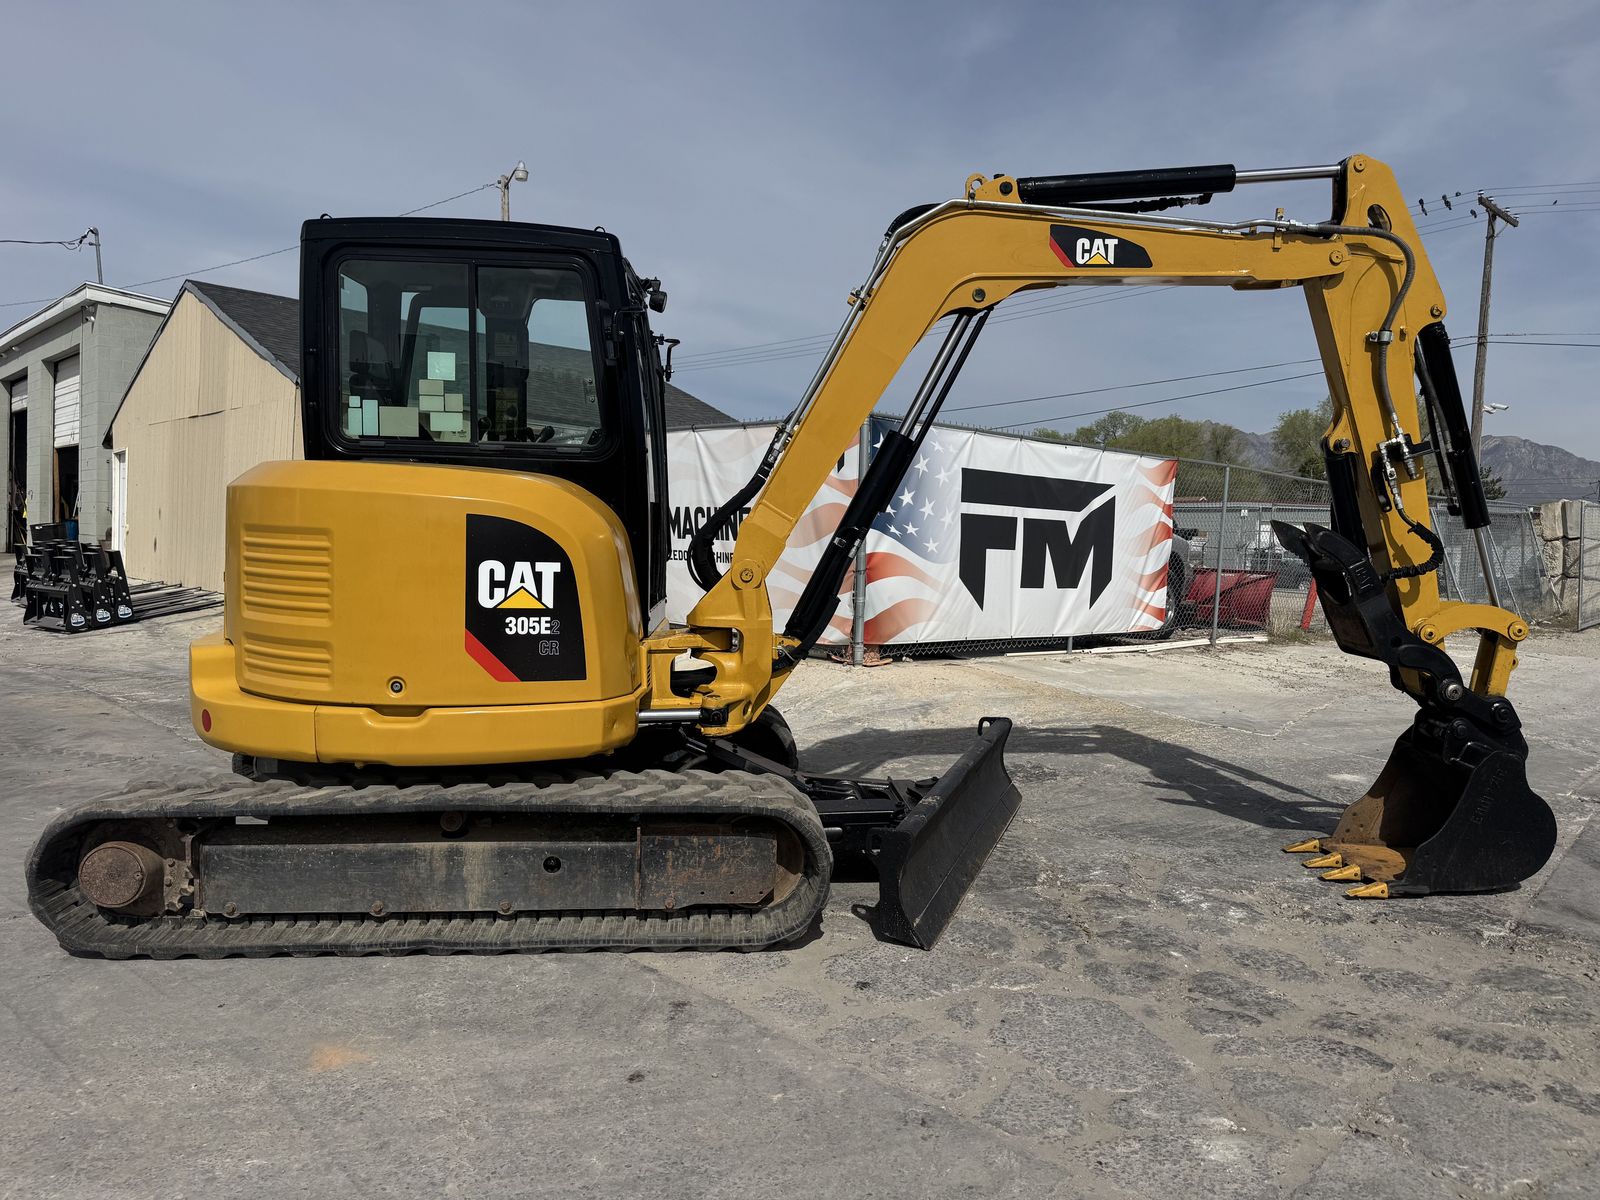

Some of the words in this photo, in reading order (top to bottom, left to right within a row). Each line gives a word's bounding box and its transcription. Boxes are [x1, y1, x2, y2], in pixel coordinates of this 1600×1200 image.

[1076, 237, 1119, 265] CAT
[958, 466, 1117, 612] FM
[478, 559, 561, 609] CAT
[505, 616, 561, 635] 305E2
[538, 640, 560, 656] CR
